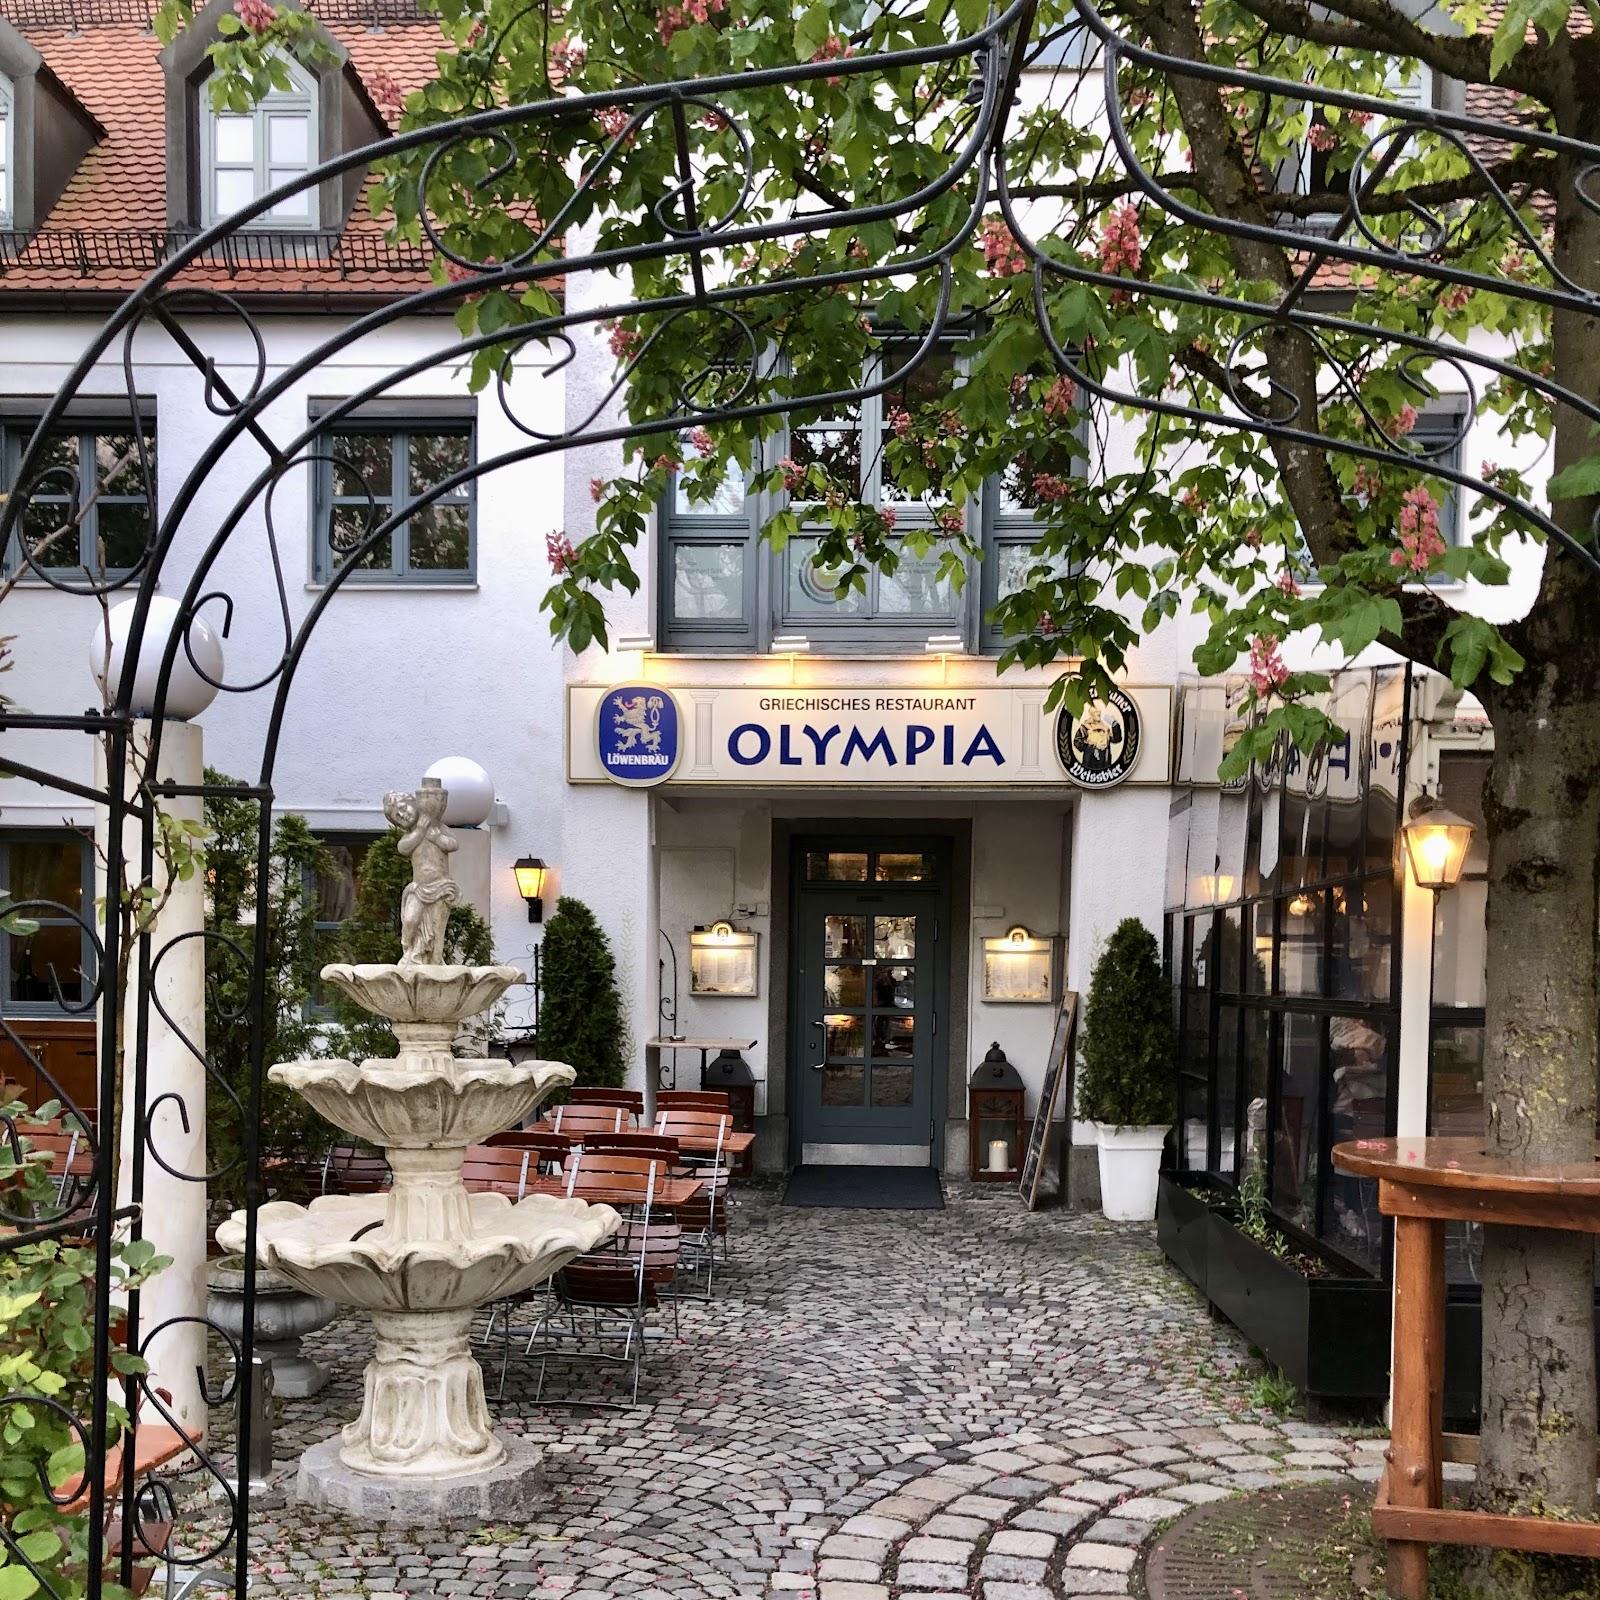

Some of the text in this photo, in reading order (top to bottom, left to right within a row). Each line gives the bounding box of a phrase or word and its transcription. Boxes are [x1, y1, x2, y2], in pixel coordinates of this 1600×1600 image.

[759, 698, 976, 711] GRIECHISCHES RESTAURANT
[727, 723, 1006, 767] OLYMPIA
[607, 752, 669, 766] LÖWENBRÄU
[1069, 761, 1124, 783] Weissbier
